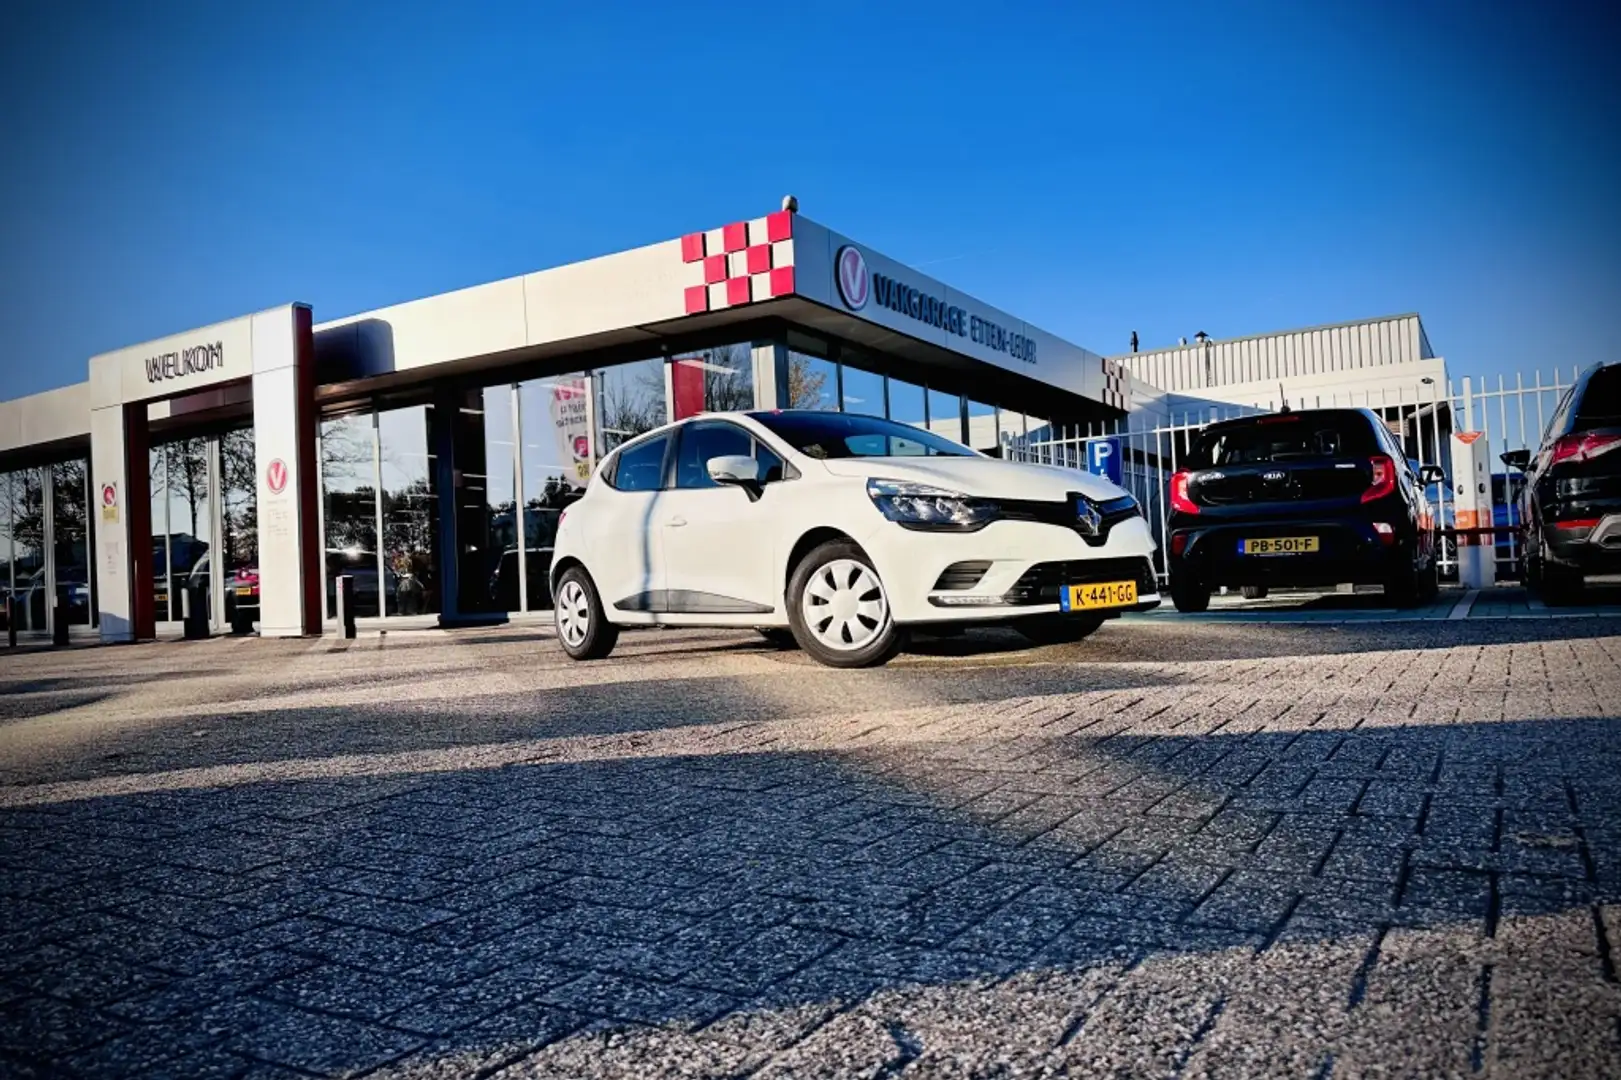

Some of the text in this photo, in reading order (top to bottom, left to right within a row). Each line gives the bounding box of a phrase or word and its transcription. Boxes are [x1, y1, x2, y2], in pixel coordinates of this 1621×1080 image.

[873, 273, 1037, 364] VAKGARAGE ETTEN-LEUR
[145, 341, 223, 383] WELKOM
[1094, 442, 1113, 467] P
[1251, 538, 1312, 552] PB-501-F
[1076, 584, 1133, 606] K-441-GG
